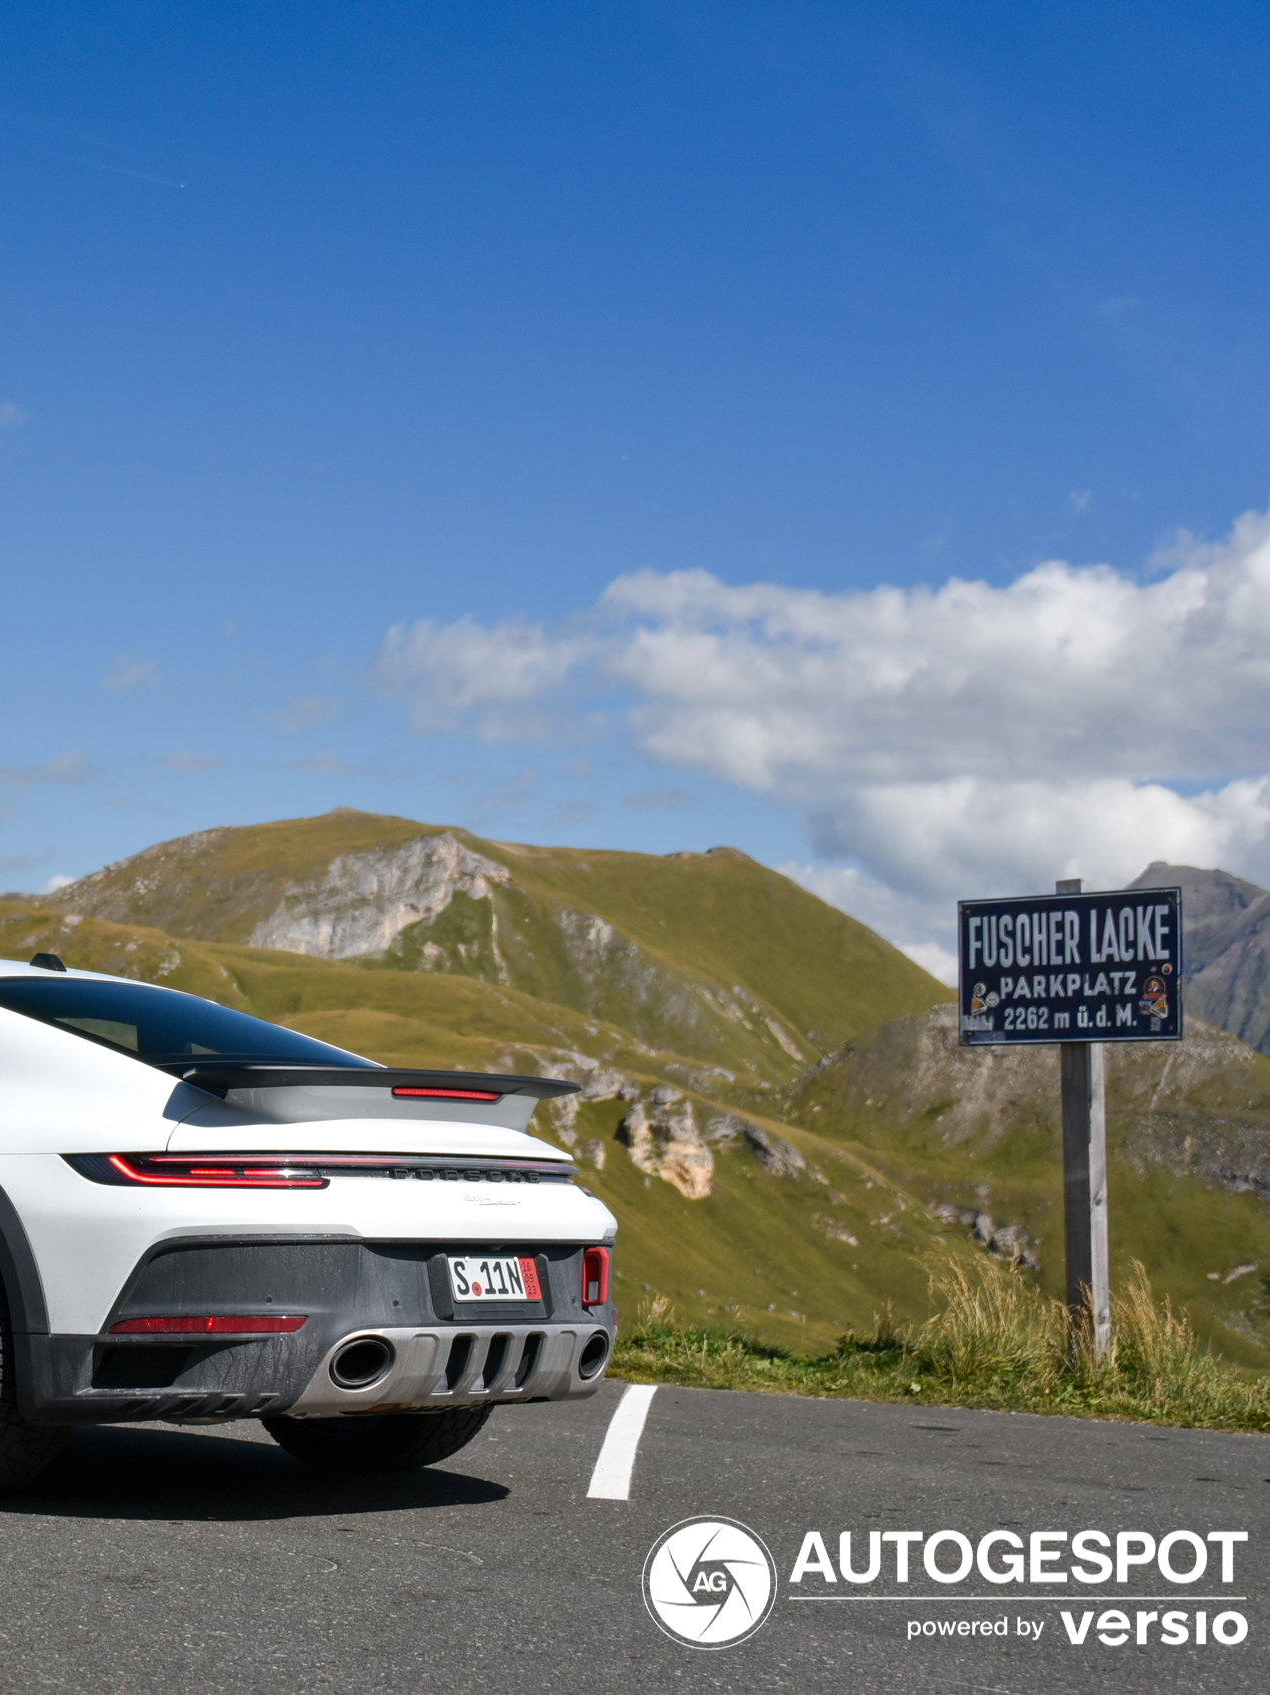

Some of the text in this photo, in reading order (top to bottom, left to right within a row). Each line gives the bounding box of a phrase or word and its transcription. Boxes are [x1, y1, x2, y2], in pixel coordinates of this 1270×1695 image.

[968, 904, 1170, 970] FUSCHER LACKE
[1000, 971, 1138, 1000] PARKPLATZ
[1003, 1006, 1049, 1031] 2262
[1053, 1011, 1070, 1029] m
[391, 1168, 541, 1184] PORSCHE
[453, 1260, 470, 1296] S
